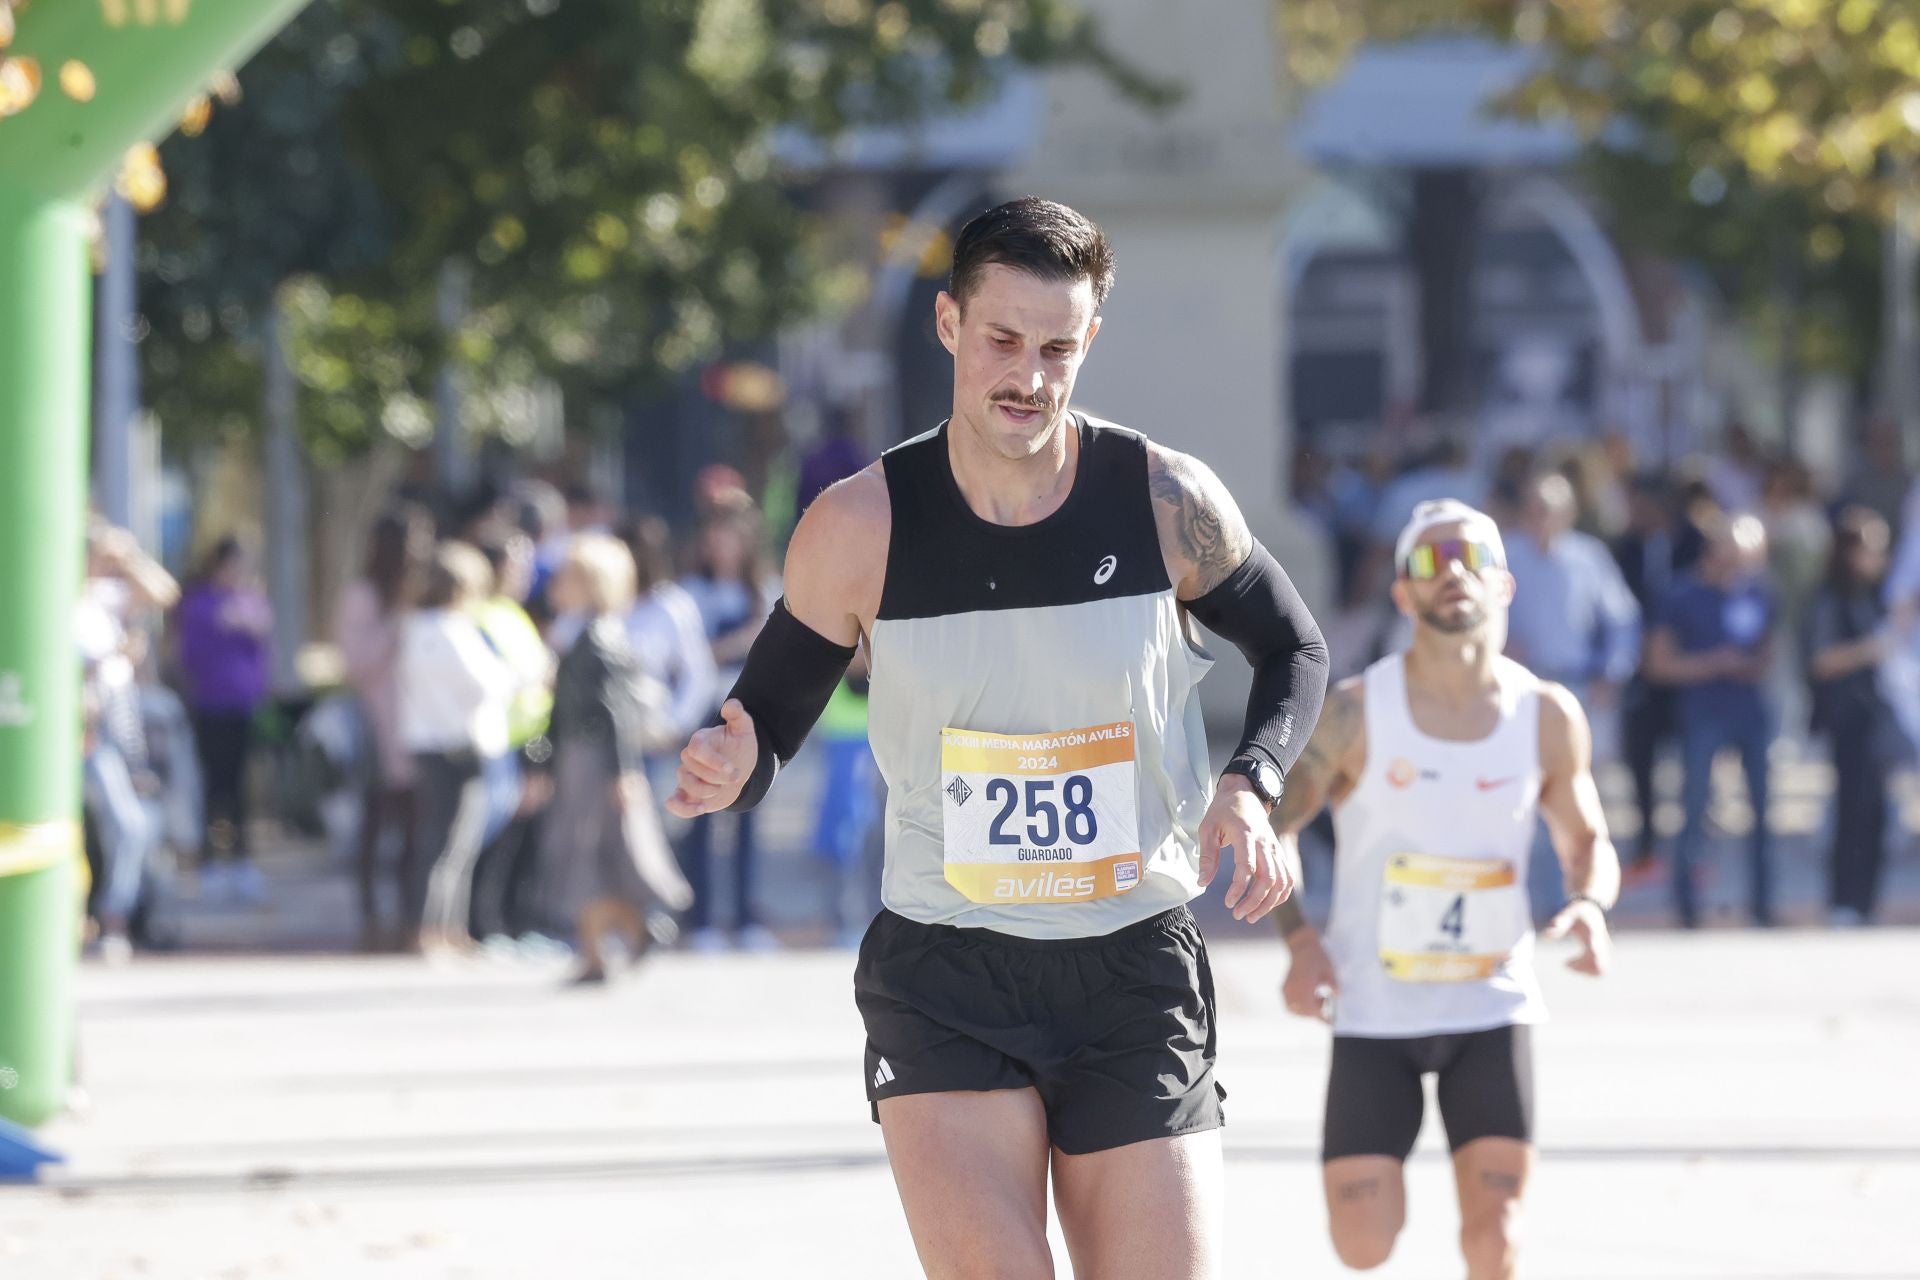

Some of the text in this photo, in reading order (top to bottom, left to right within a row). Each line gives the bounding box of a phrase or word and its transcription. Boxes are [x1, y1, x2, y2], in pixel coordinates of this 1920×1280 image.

[982, 738, 1020, 750] MEDIA
[1023, 732, 1085, 750] MARATÓN
[1088, 724, 1130, 743] AVILÉS
[1017, 756, 1058, 769] 2024
[985, 775, 1098, 847] 258
[1018, 847, 1073, 861] GUARDADO
[993, 872, 1096, 897] avilés
[1439, 892, 1465, 939] 4
